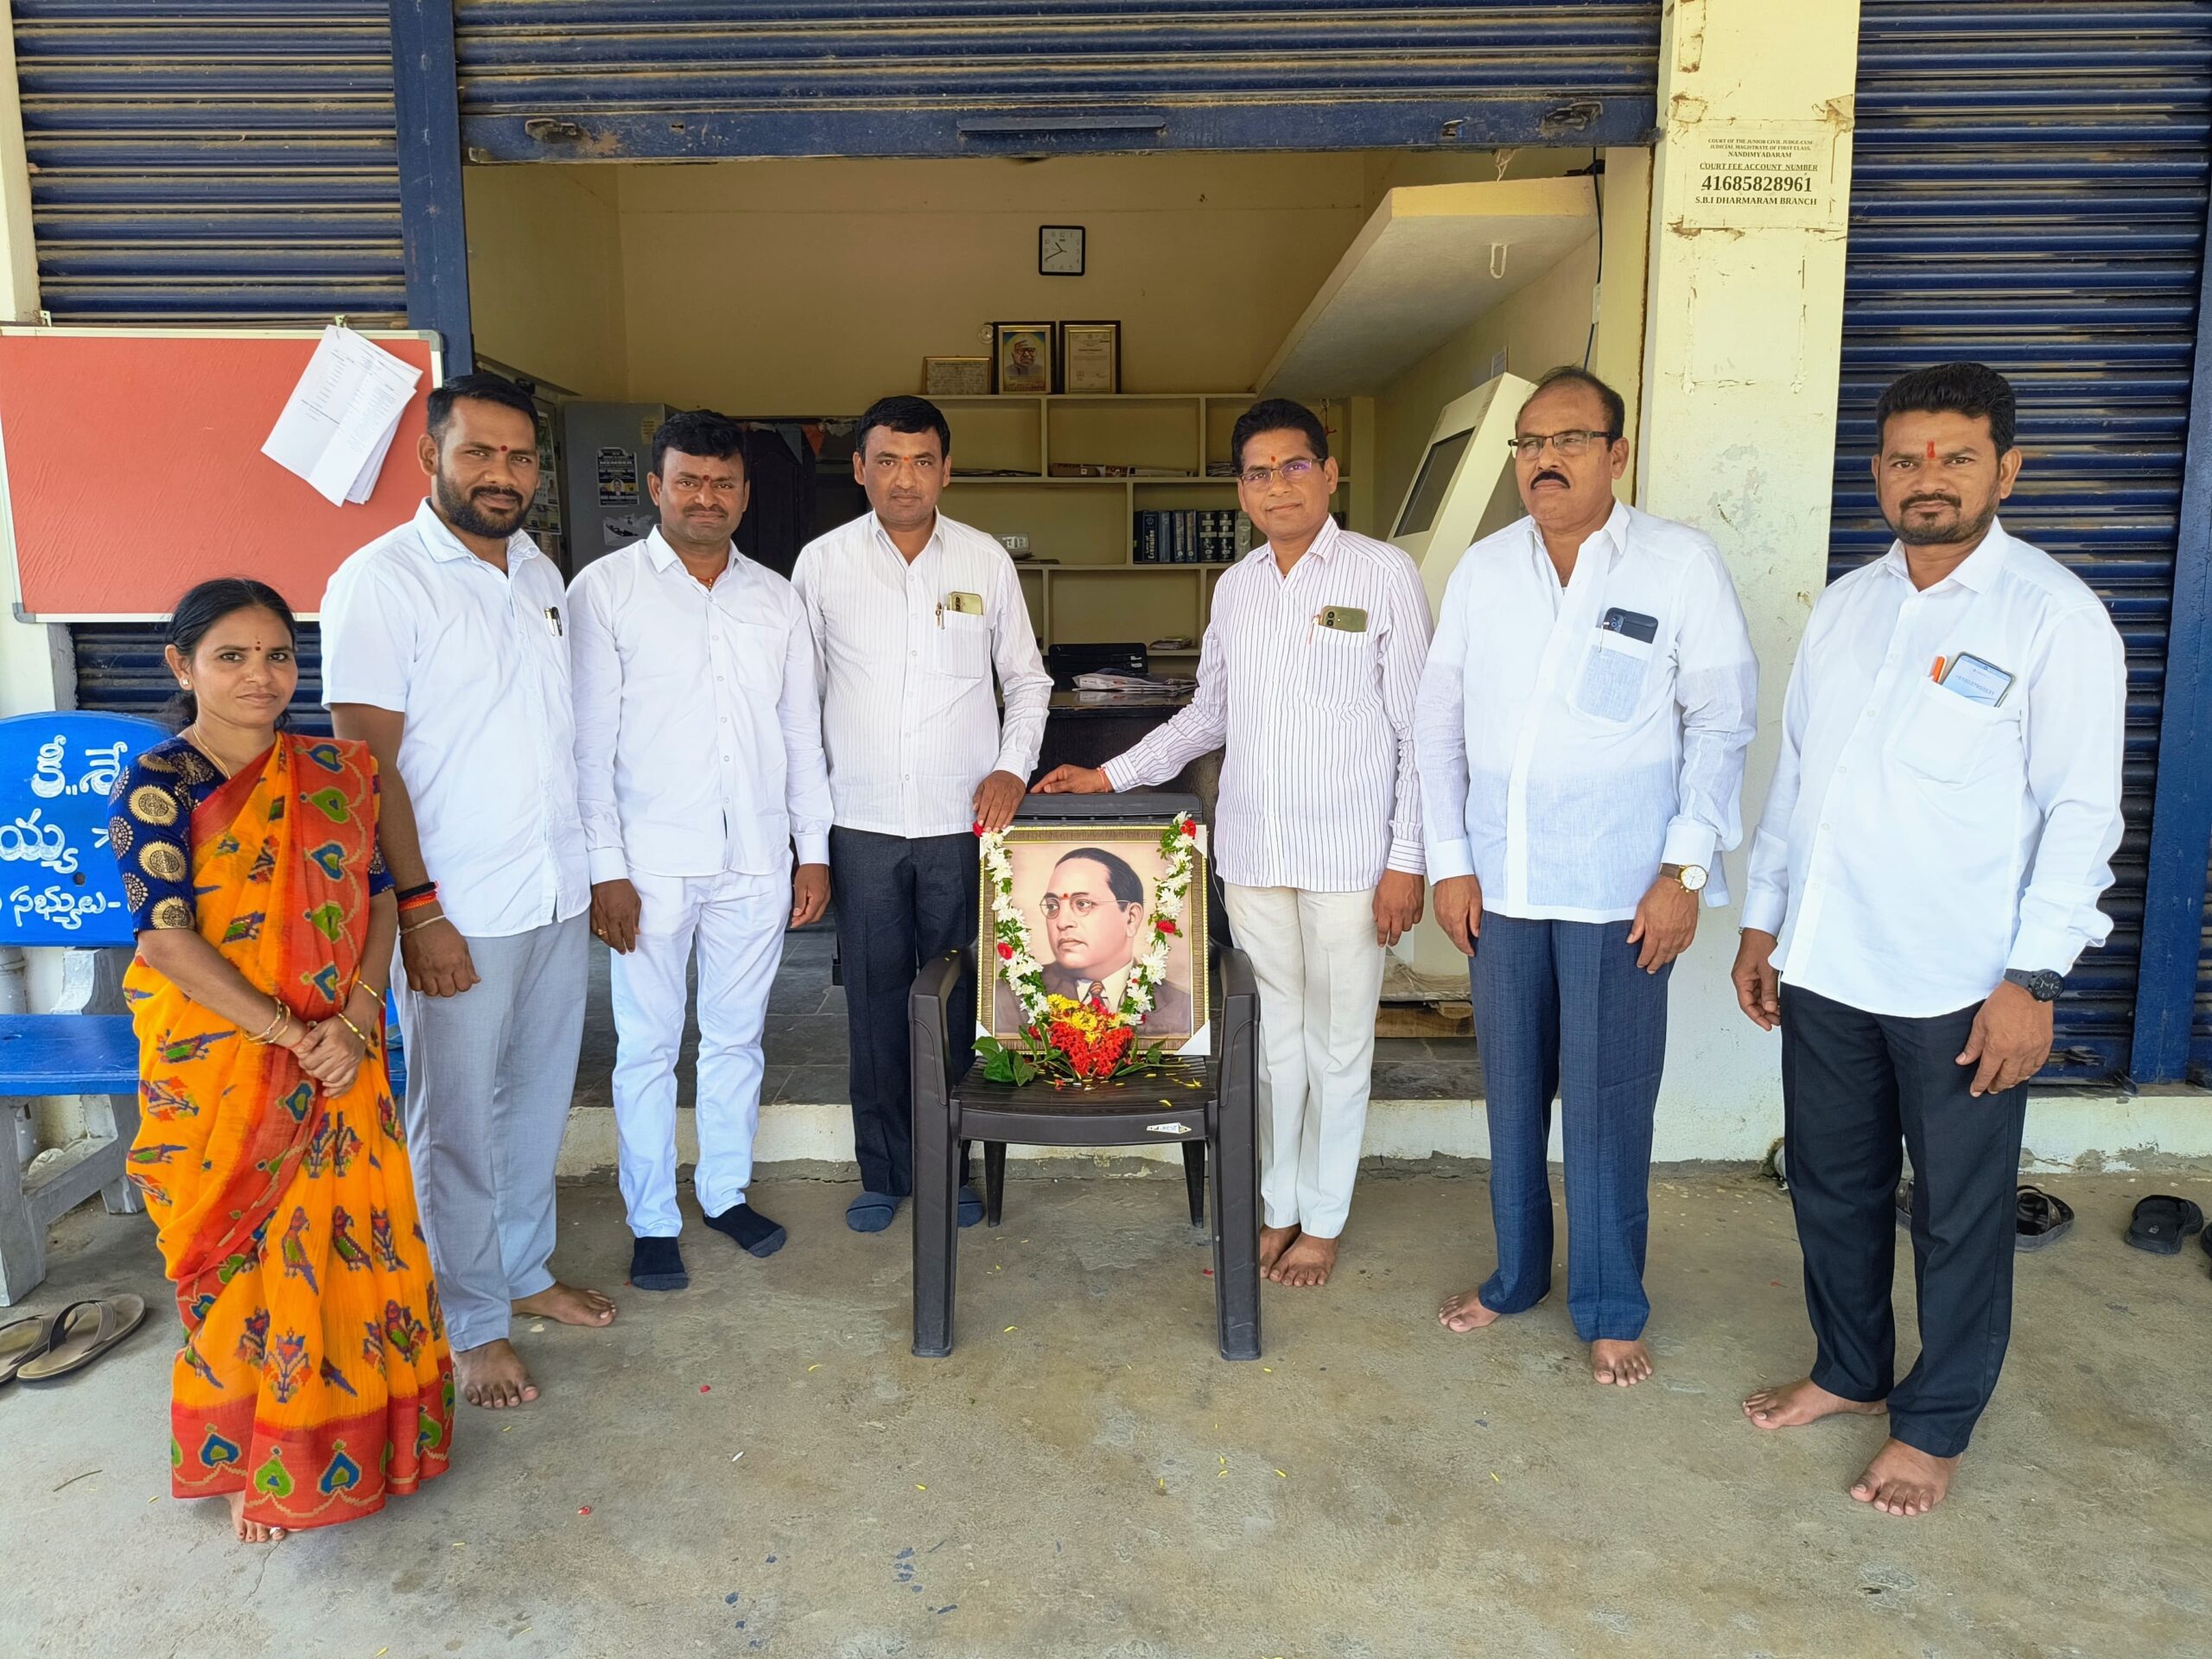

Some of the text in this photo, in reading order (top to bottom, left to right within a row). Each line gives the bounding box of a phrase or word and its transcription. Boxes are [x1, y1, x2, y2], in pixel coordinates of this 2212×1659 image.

[1727, 162, 1743, 171] FEE
[1745, 162, 1783, 171] ACCOUNT
[1701, 175, 1812, 192] 41685828961
[1715, 196, 1777, 205] DHARMARAM
[1779, 197, 1817, 206] BRANCH
